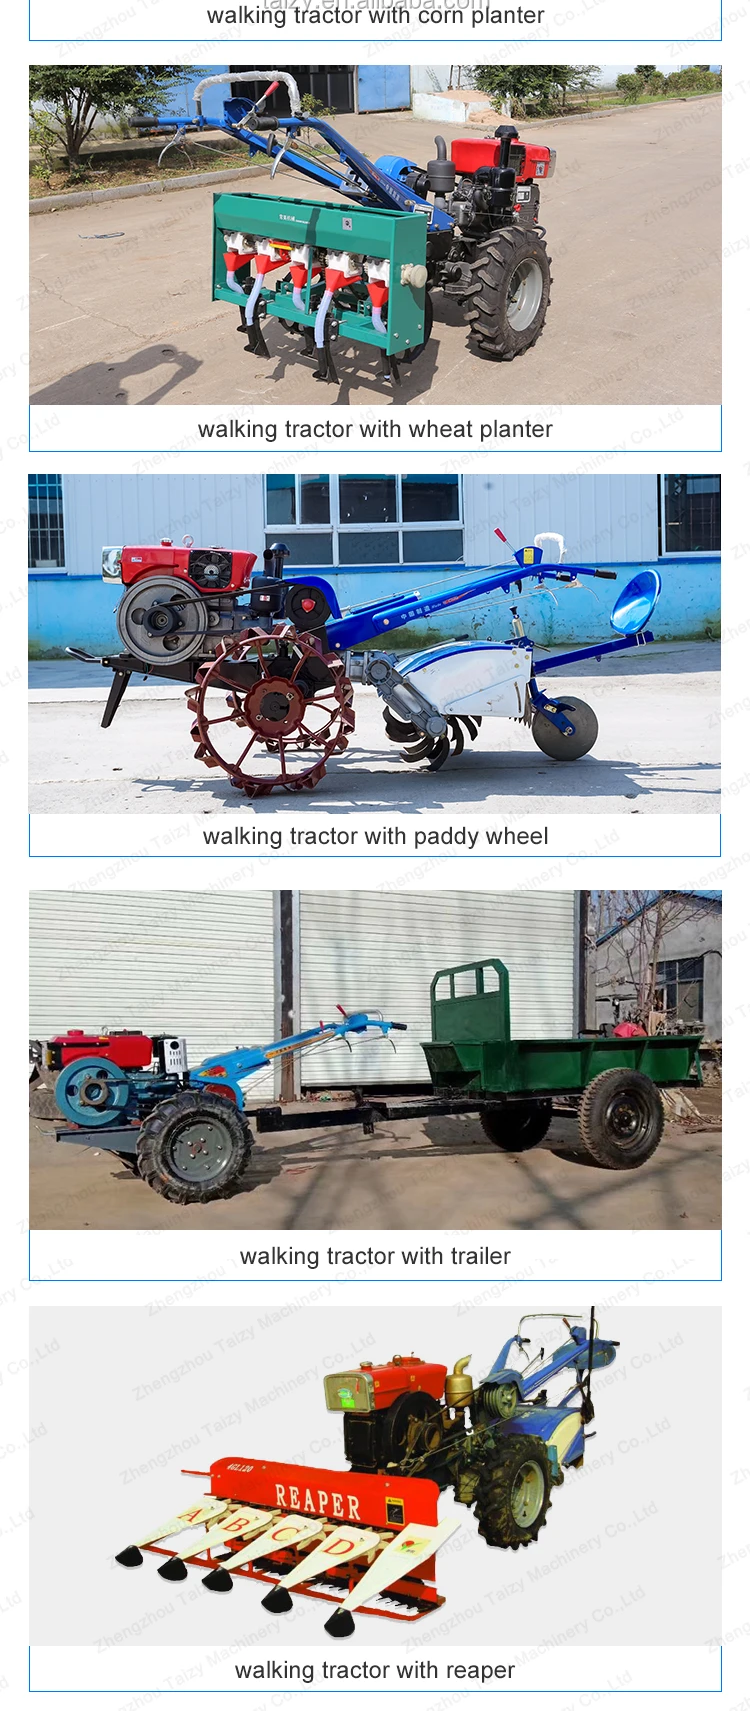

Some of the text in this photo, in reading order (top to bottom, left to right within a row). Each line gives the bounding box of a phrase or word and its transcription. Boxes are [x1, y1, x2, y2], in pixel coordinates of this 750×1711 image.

[275, 1484, 361, 1521] REAPER
[178, 1508, 204, 1522] A
[222, 1517, 250, 1532] B
[272, 1526, 300, 1542] C
[322, 1538, 355, 1555] D
